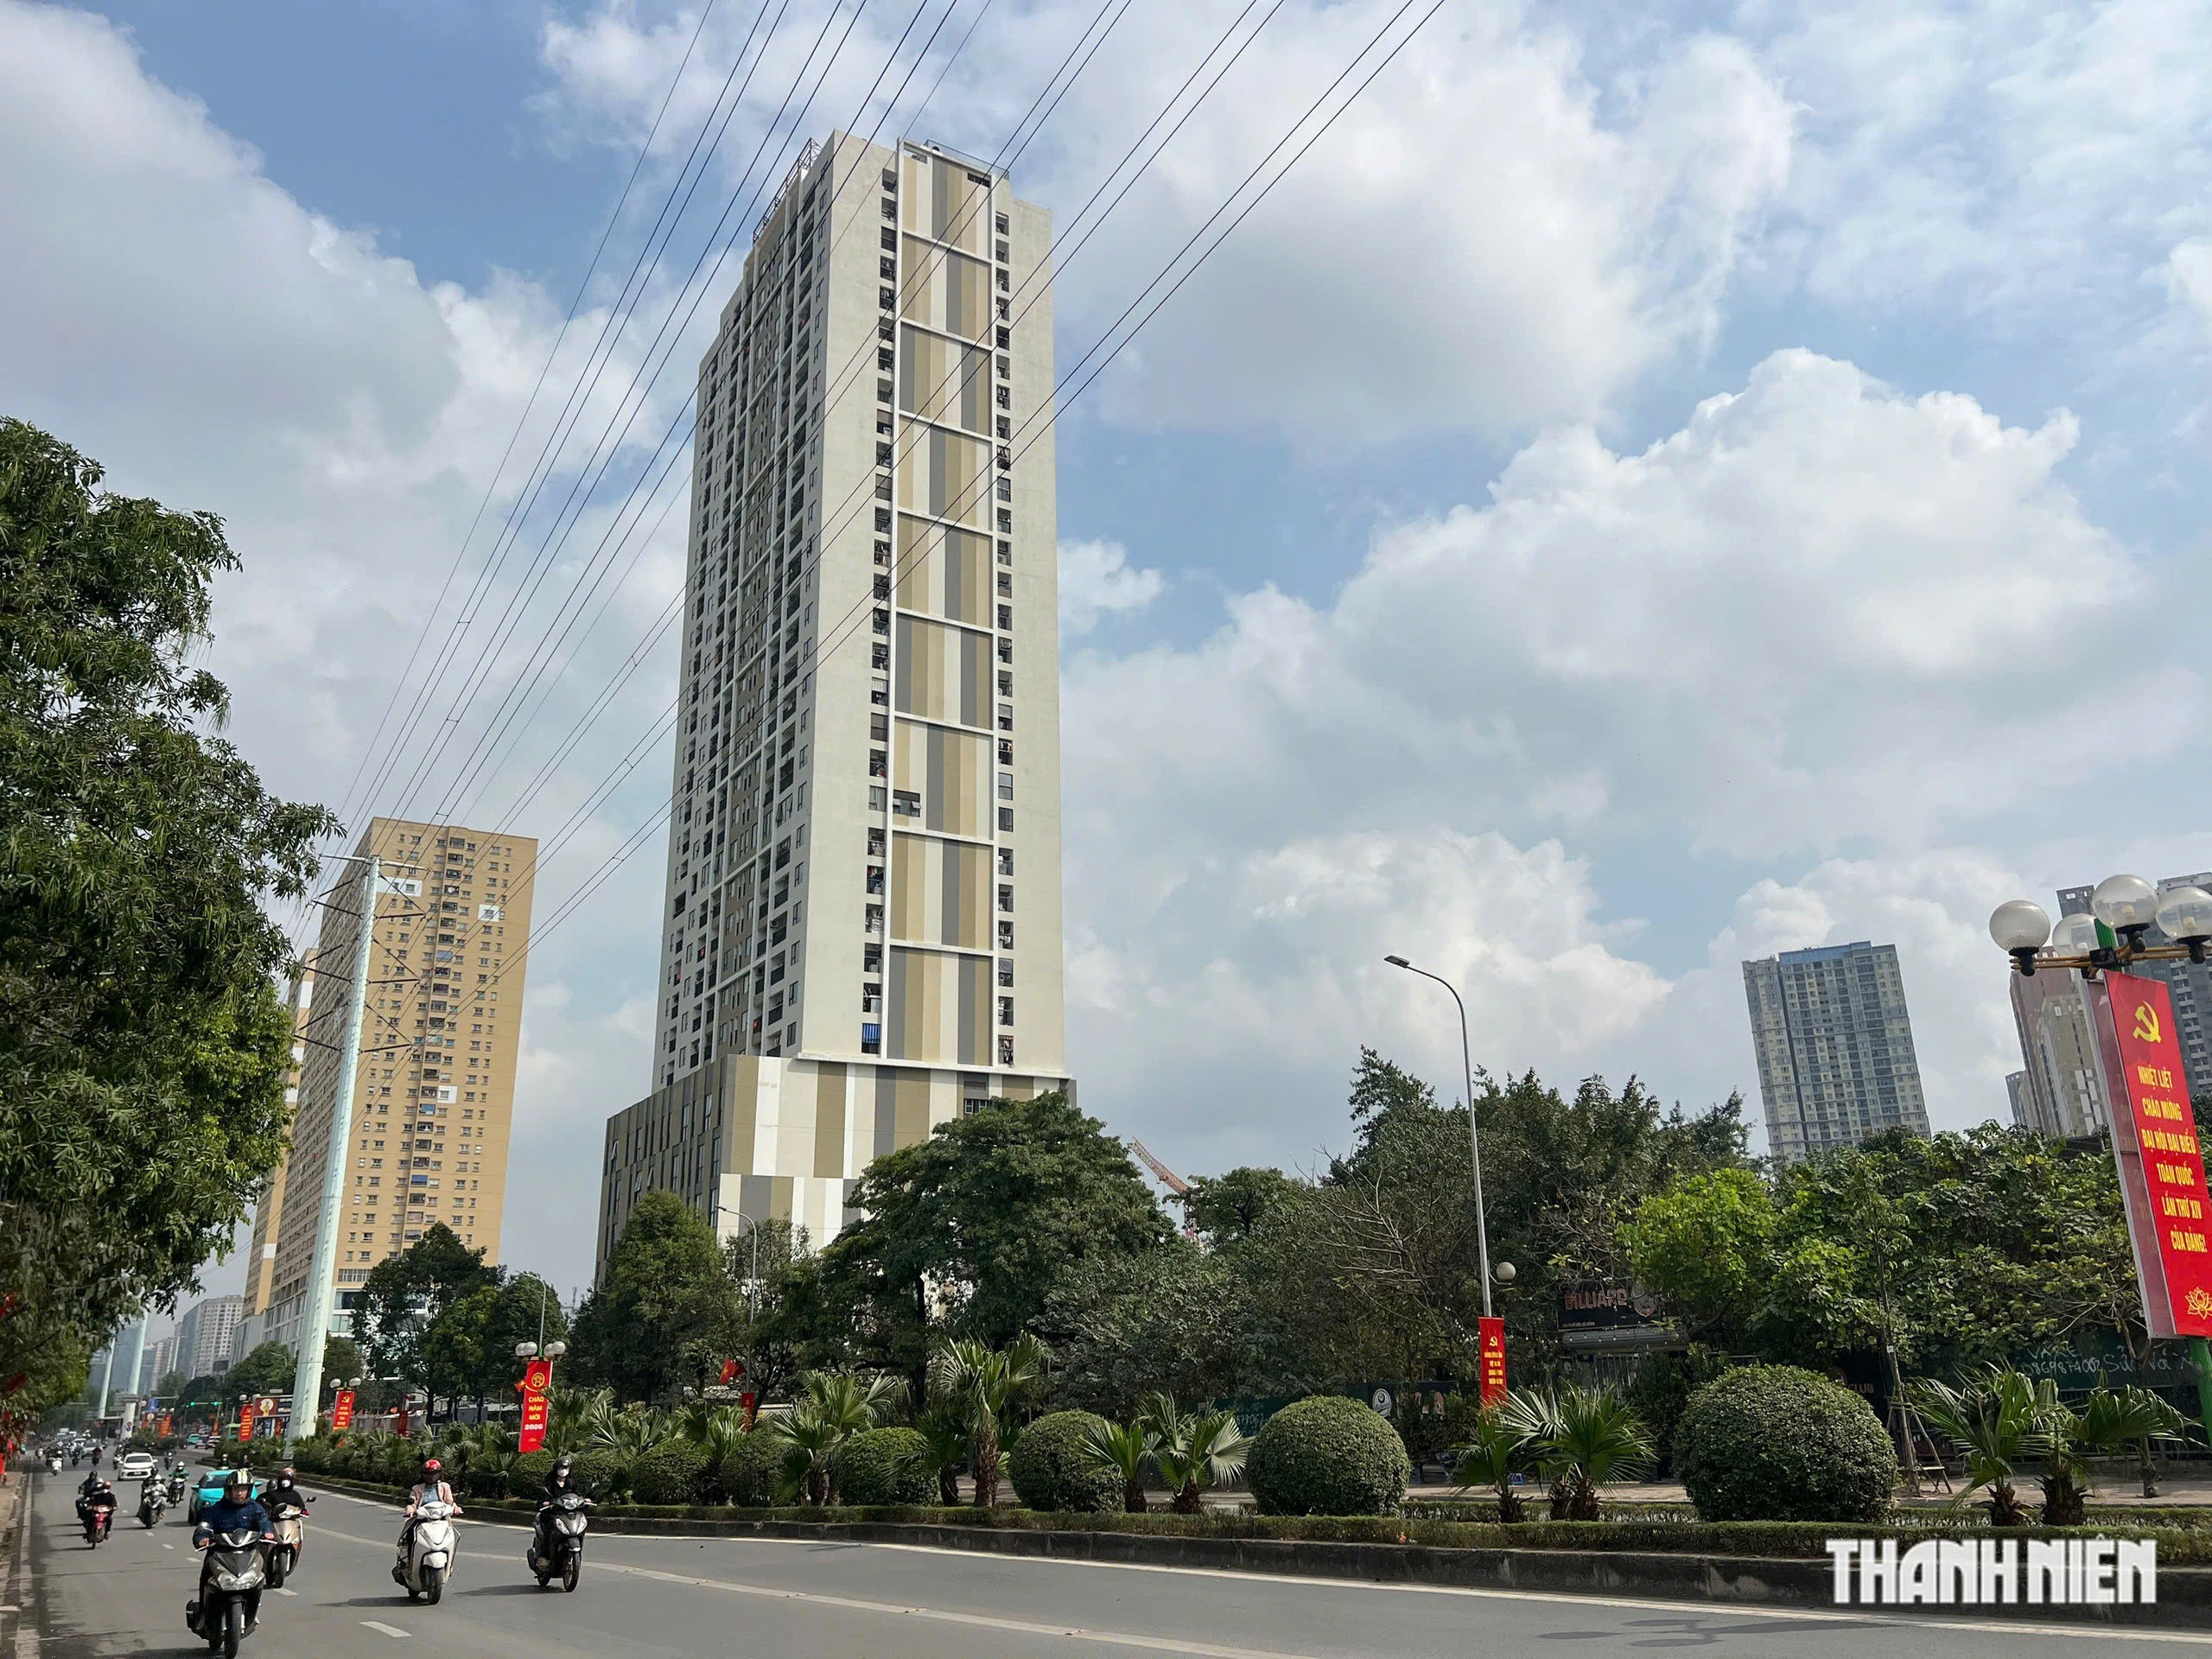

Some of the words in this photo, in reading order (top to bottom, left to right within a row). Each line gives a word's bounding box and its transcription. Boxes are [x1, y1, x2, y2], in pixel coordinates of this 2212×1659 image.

[2137, 1064, 2158, 1090] NHIỆT
[2158, 1066, 2173, 1092] LIỆT
[2142, 1095, 2161, 1118] CHÀO
[2160, 1097, 2183, 1122] MỪNG
[2141, 1128, 2156, 1153] ĐẠI
[2154, 1128, 2169, 1154] HỘI
[2166, 1132, 2181, 1156] ĐẠI
[2178, 1128, 2196, 1154] BIỂU
[2156, 1160, 2176, 1184] TOÀN
[2175, 1160, 2195, 1186] QUỐC
[2161, 1190, 2177, 1217] LẦN
[2176, 1195, 2191, 1218] THỨ
[2189, 1200, 2202, 1219] XIV
[2170, 1224, 2186, 1250] CỦA
[2184, 1226, 2208, 1253] ĐẢNG!
[1565, 1287, 1627, 1310] BILLIARD
